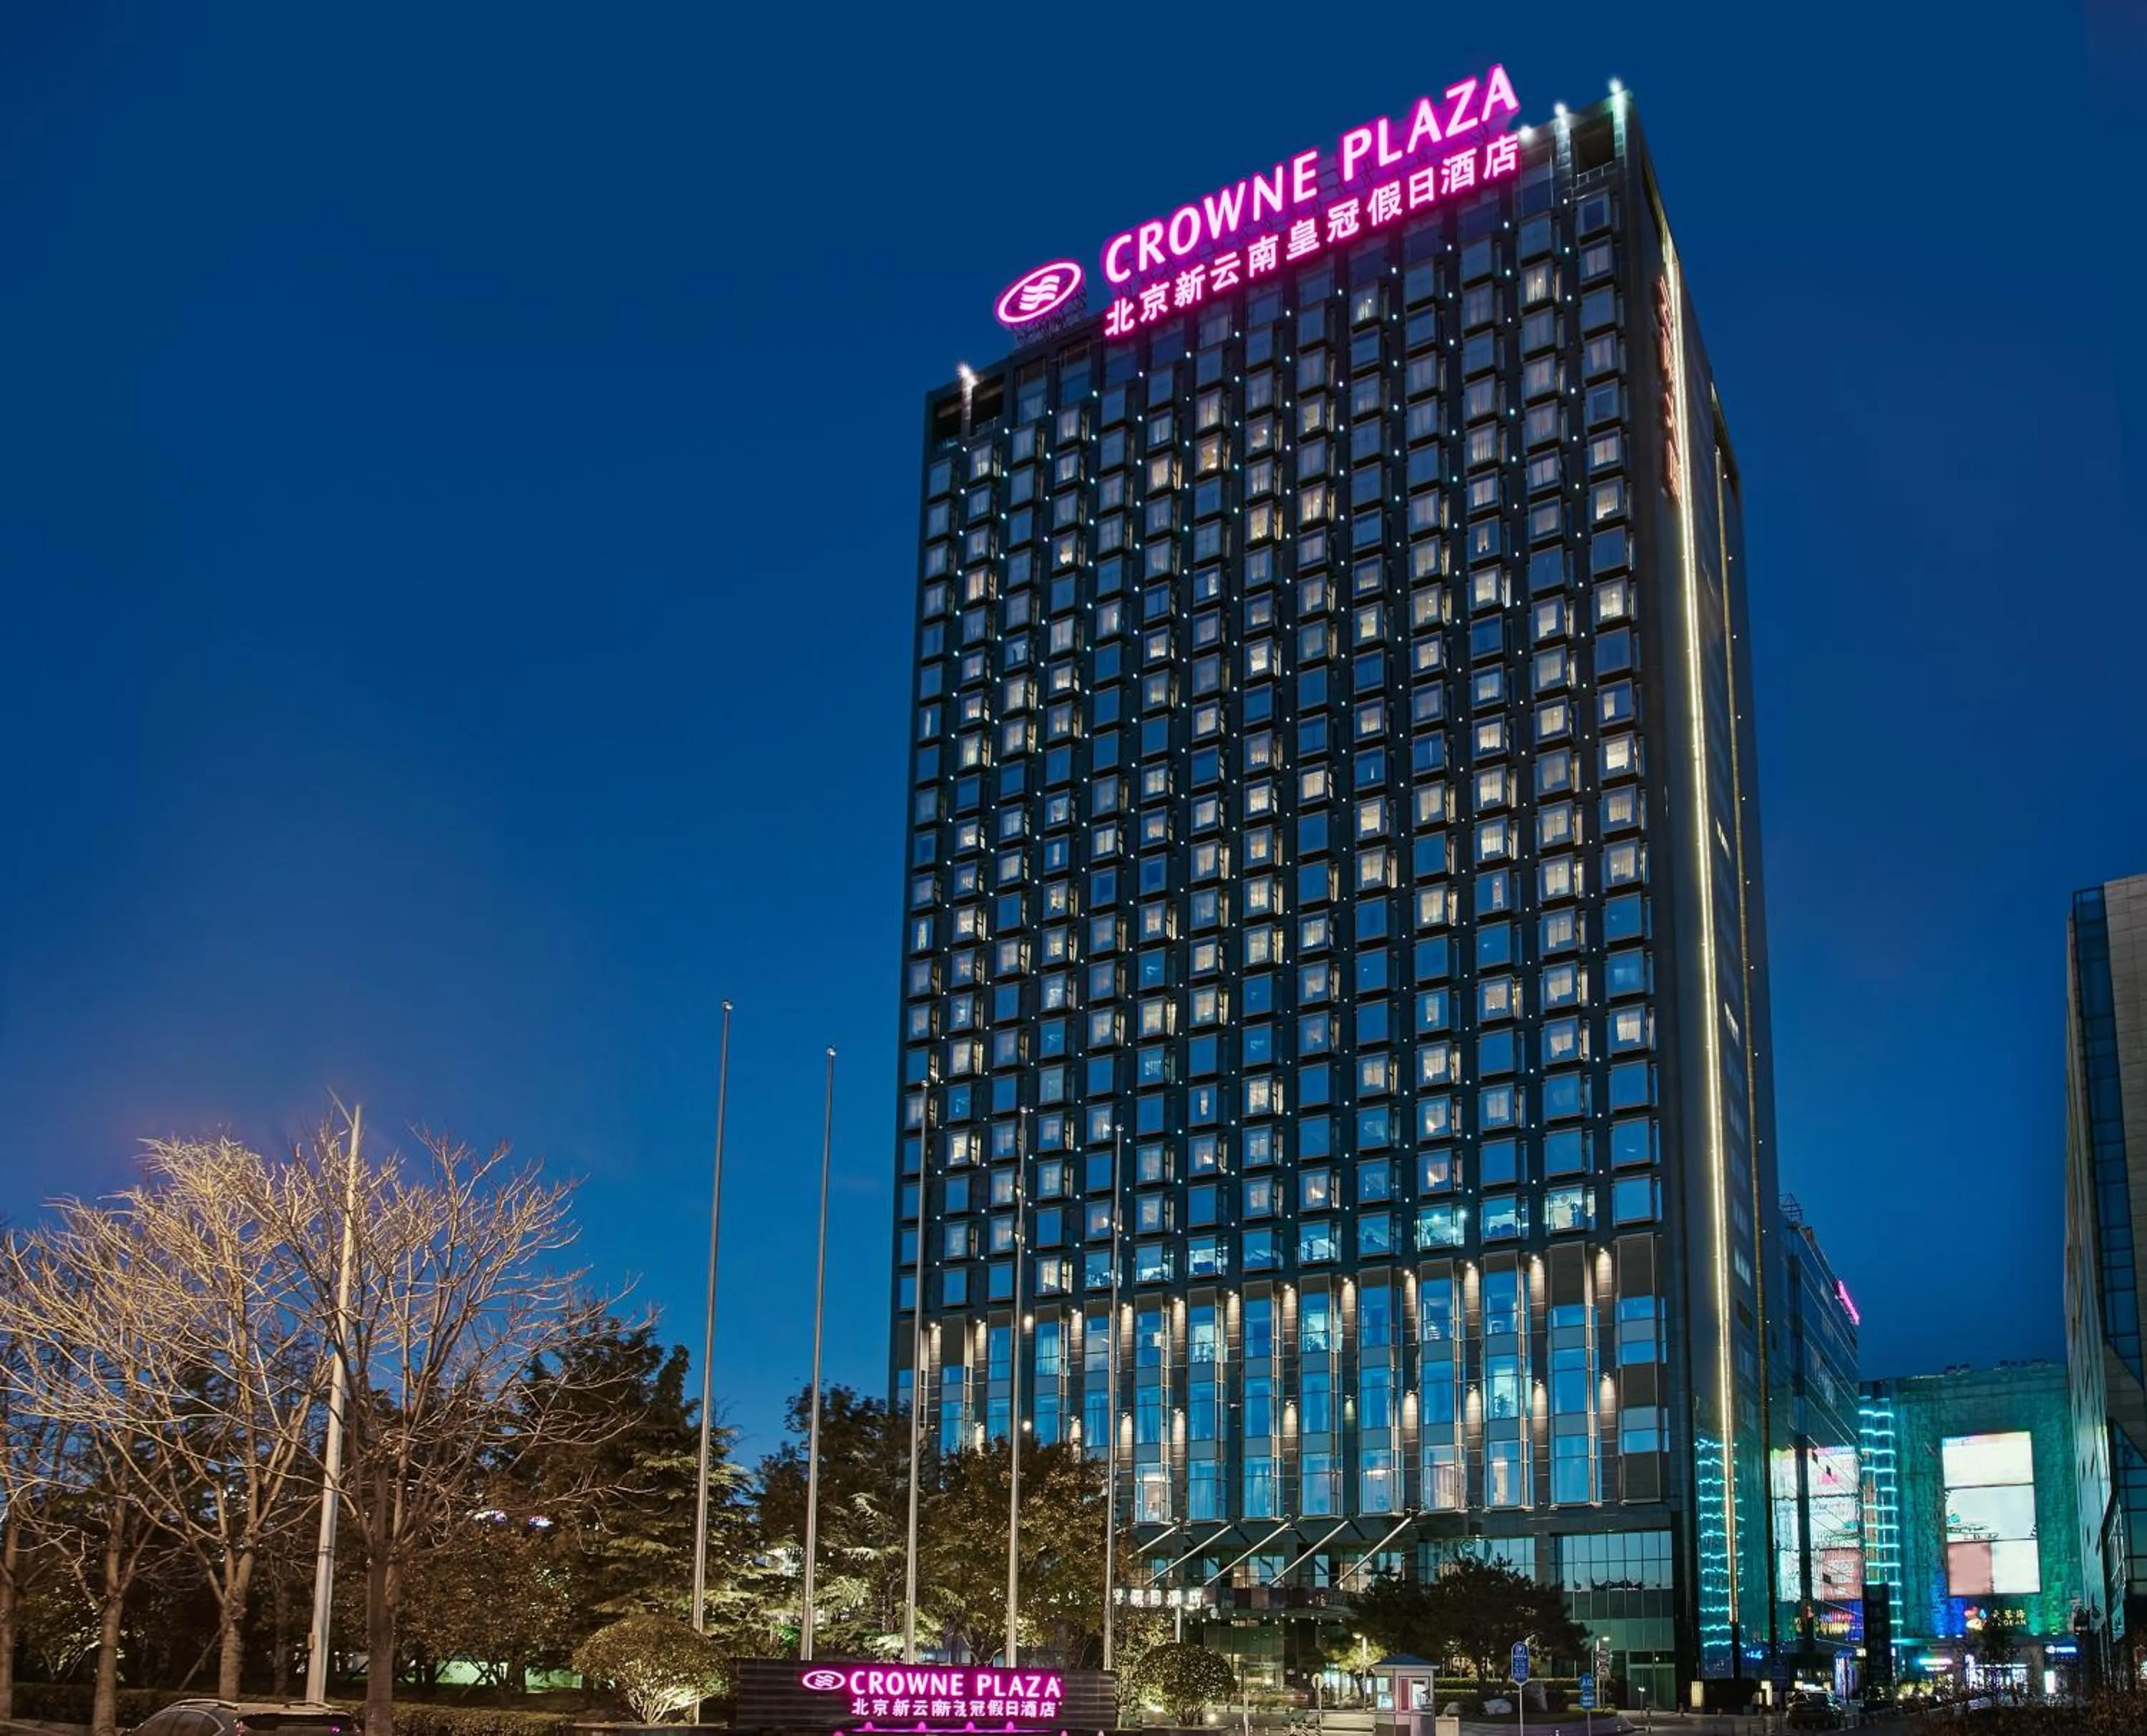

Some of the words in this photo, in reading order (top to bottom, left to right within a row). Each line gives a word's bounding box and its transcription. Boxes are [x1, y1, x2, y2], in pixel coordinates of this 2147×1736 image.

[1104, 133, 1519, 337] 北京新云南皇冠假日酒店
[1106, 150, 1318, 283] CROWNE
[1342, 64, 1520, 182] PLAZA
[850, 1671, 963, 1695] CROWNE
[977, 1674, 1061, 1698] PLAZA
